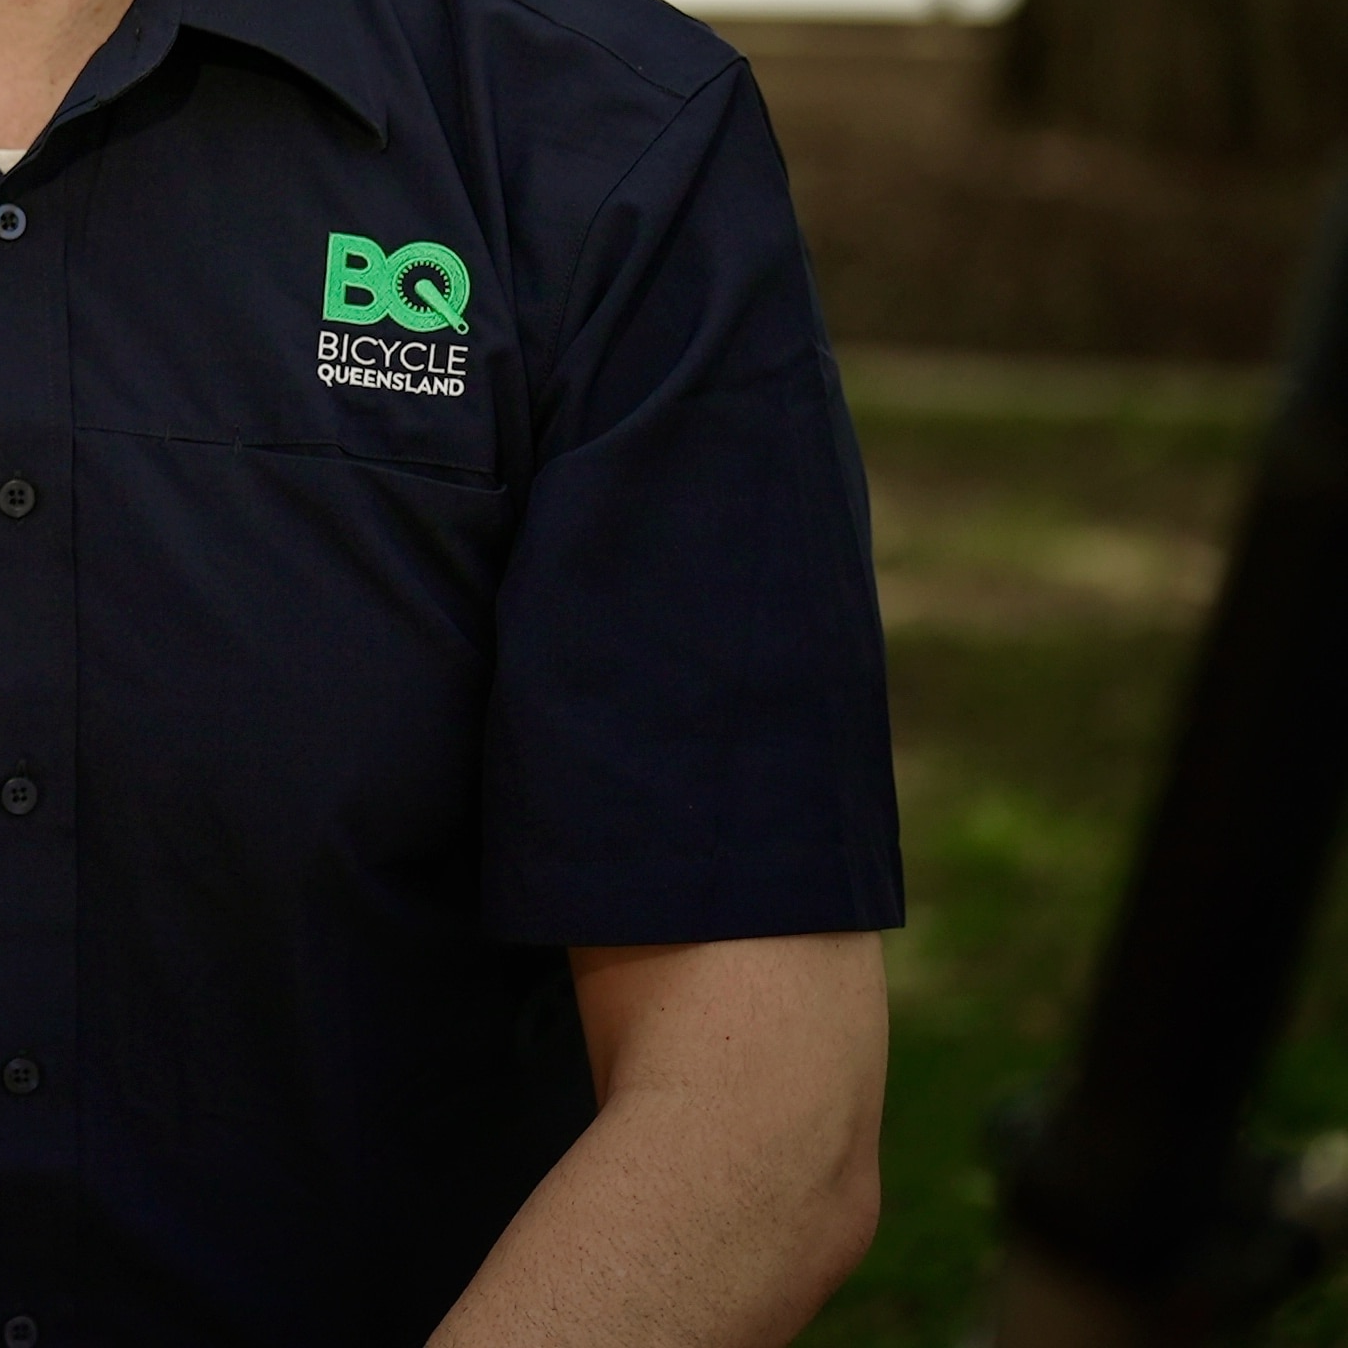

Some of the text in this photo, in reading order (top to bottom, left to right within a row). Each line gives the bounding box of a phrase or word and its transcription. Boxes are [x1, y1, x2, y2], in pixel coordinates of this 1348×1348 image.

[322, 232, 470, 335] BQ
[317, 330, 469, 376] BICYCLE
[316, 363, 465, 397] QUEENSLAND
